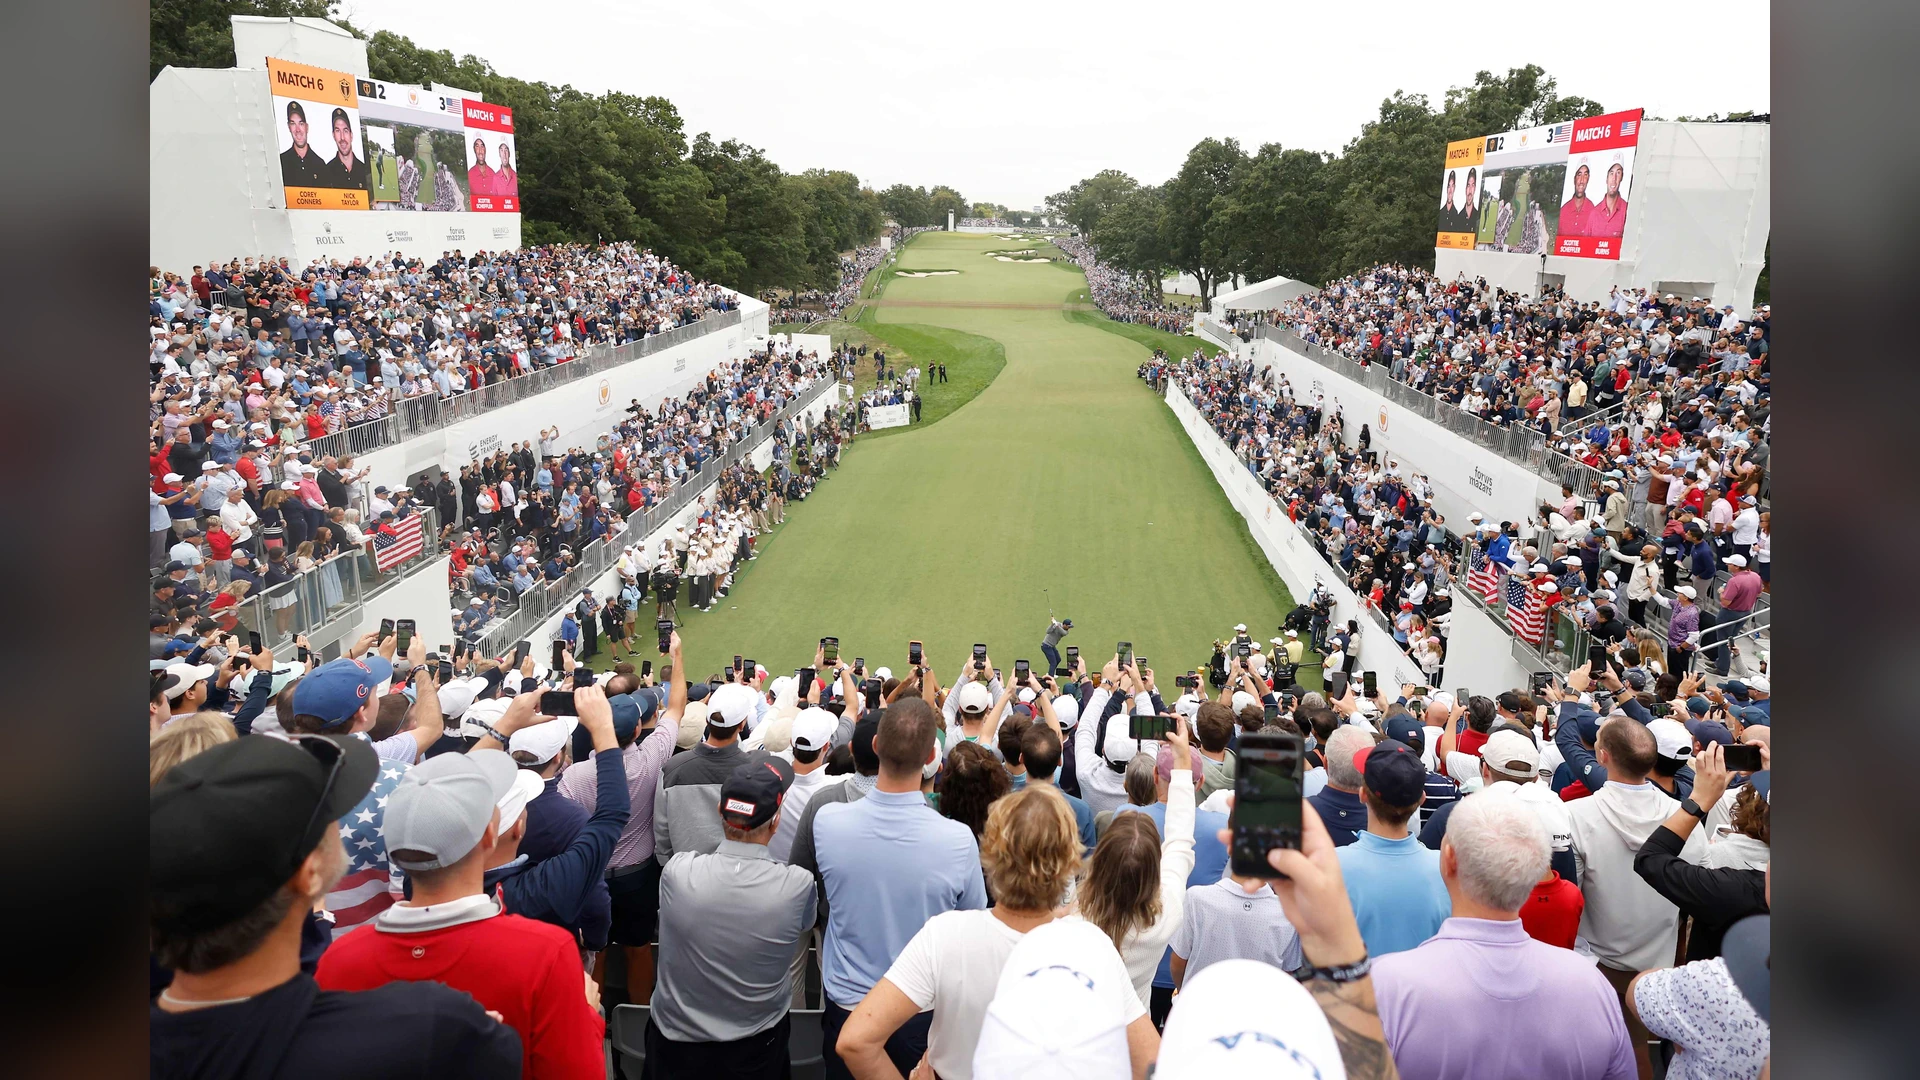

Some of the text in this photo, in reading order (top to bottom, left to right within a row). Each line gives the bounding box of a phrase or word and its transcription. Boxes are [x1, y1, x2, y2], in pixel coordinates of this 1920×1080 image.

[277, 70, 324, 91] MATCH 6
[378, 84, 386, 100] 2
[440, 97, 446, 110] 3
[466, 108, 494, 122] MATCH 6
[1546, 128, 1554, 143] 3
[1576, 125, 1611, 142] MATCH 6
[1498, 136, 1504, 150] 2
[1449, 150, 1466, 160] MATCH
[316, 236, 344, 245] ROLEX
[480, 434, 498, 447] ENERGY
[480, 440, 503, 455] TRANSFER
[1475, 466, 1492, 486] forvis
[1469, 476, 1492, 496] mazars
[357, 684, 368, 698] C
